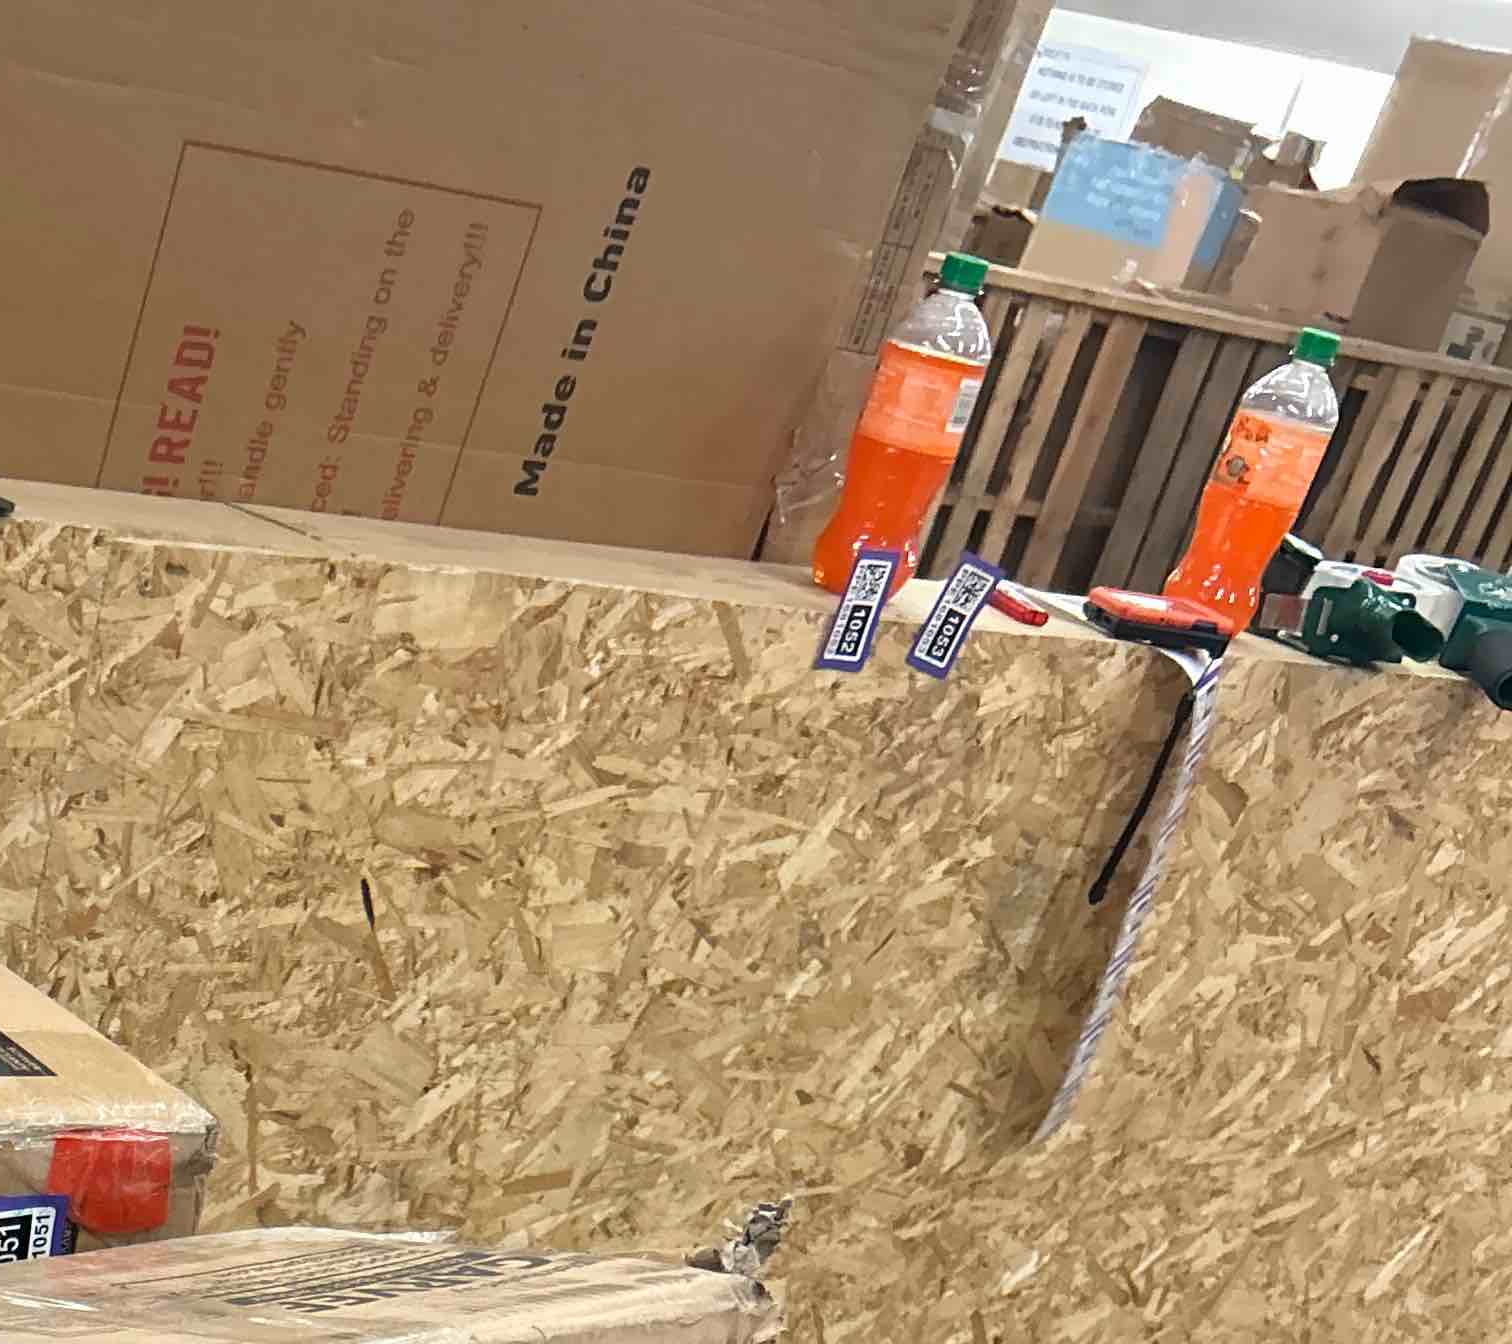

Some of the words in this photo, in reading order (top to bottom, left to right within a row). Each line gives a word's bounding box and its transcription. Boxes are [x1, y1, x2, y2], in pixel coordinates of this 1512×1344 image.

[384, 208, 415, 258] the
[373, 267, 400, 305] on
[513, 375, 576, 497] Made
[560, 319, 598, 361] in
[582, 165, 651, 303] China
[148, 324, 221, 464] READ!
[327, 314, 387, 444] Standing
[418, 374, 440, 397] &
[840, 607, 868, 655] 1052
[931, 615, 962, 658] 1053
[31, 1214, 51, 1259] 1051
